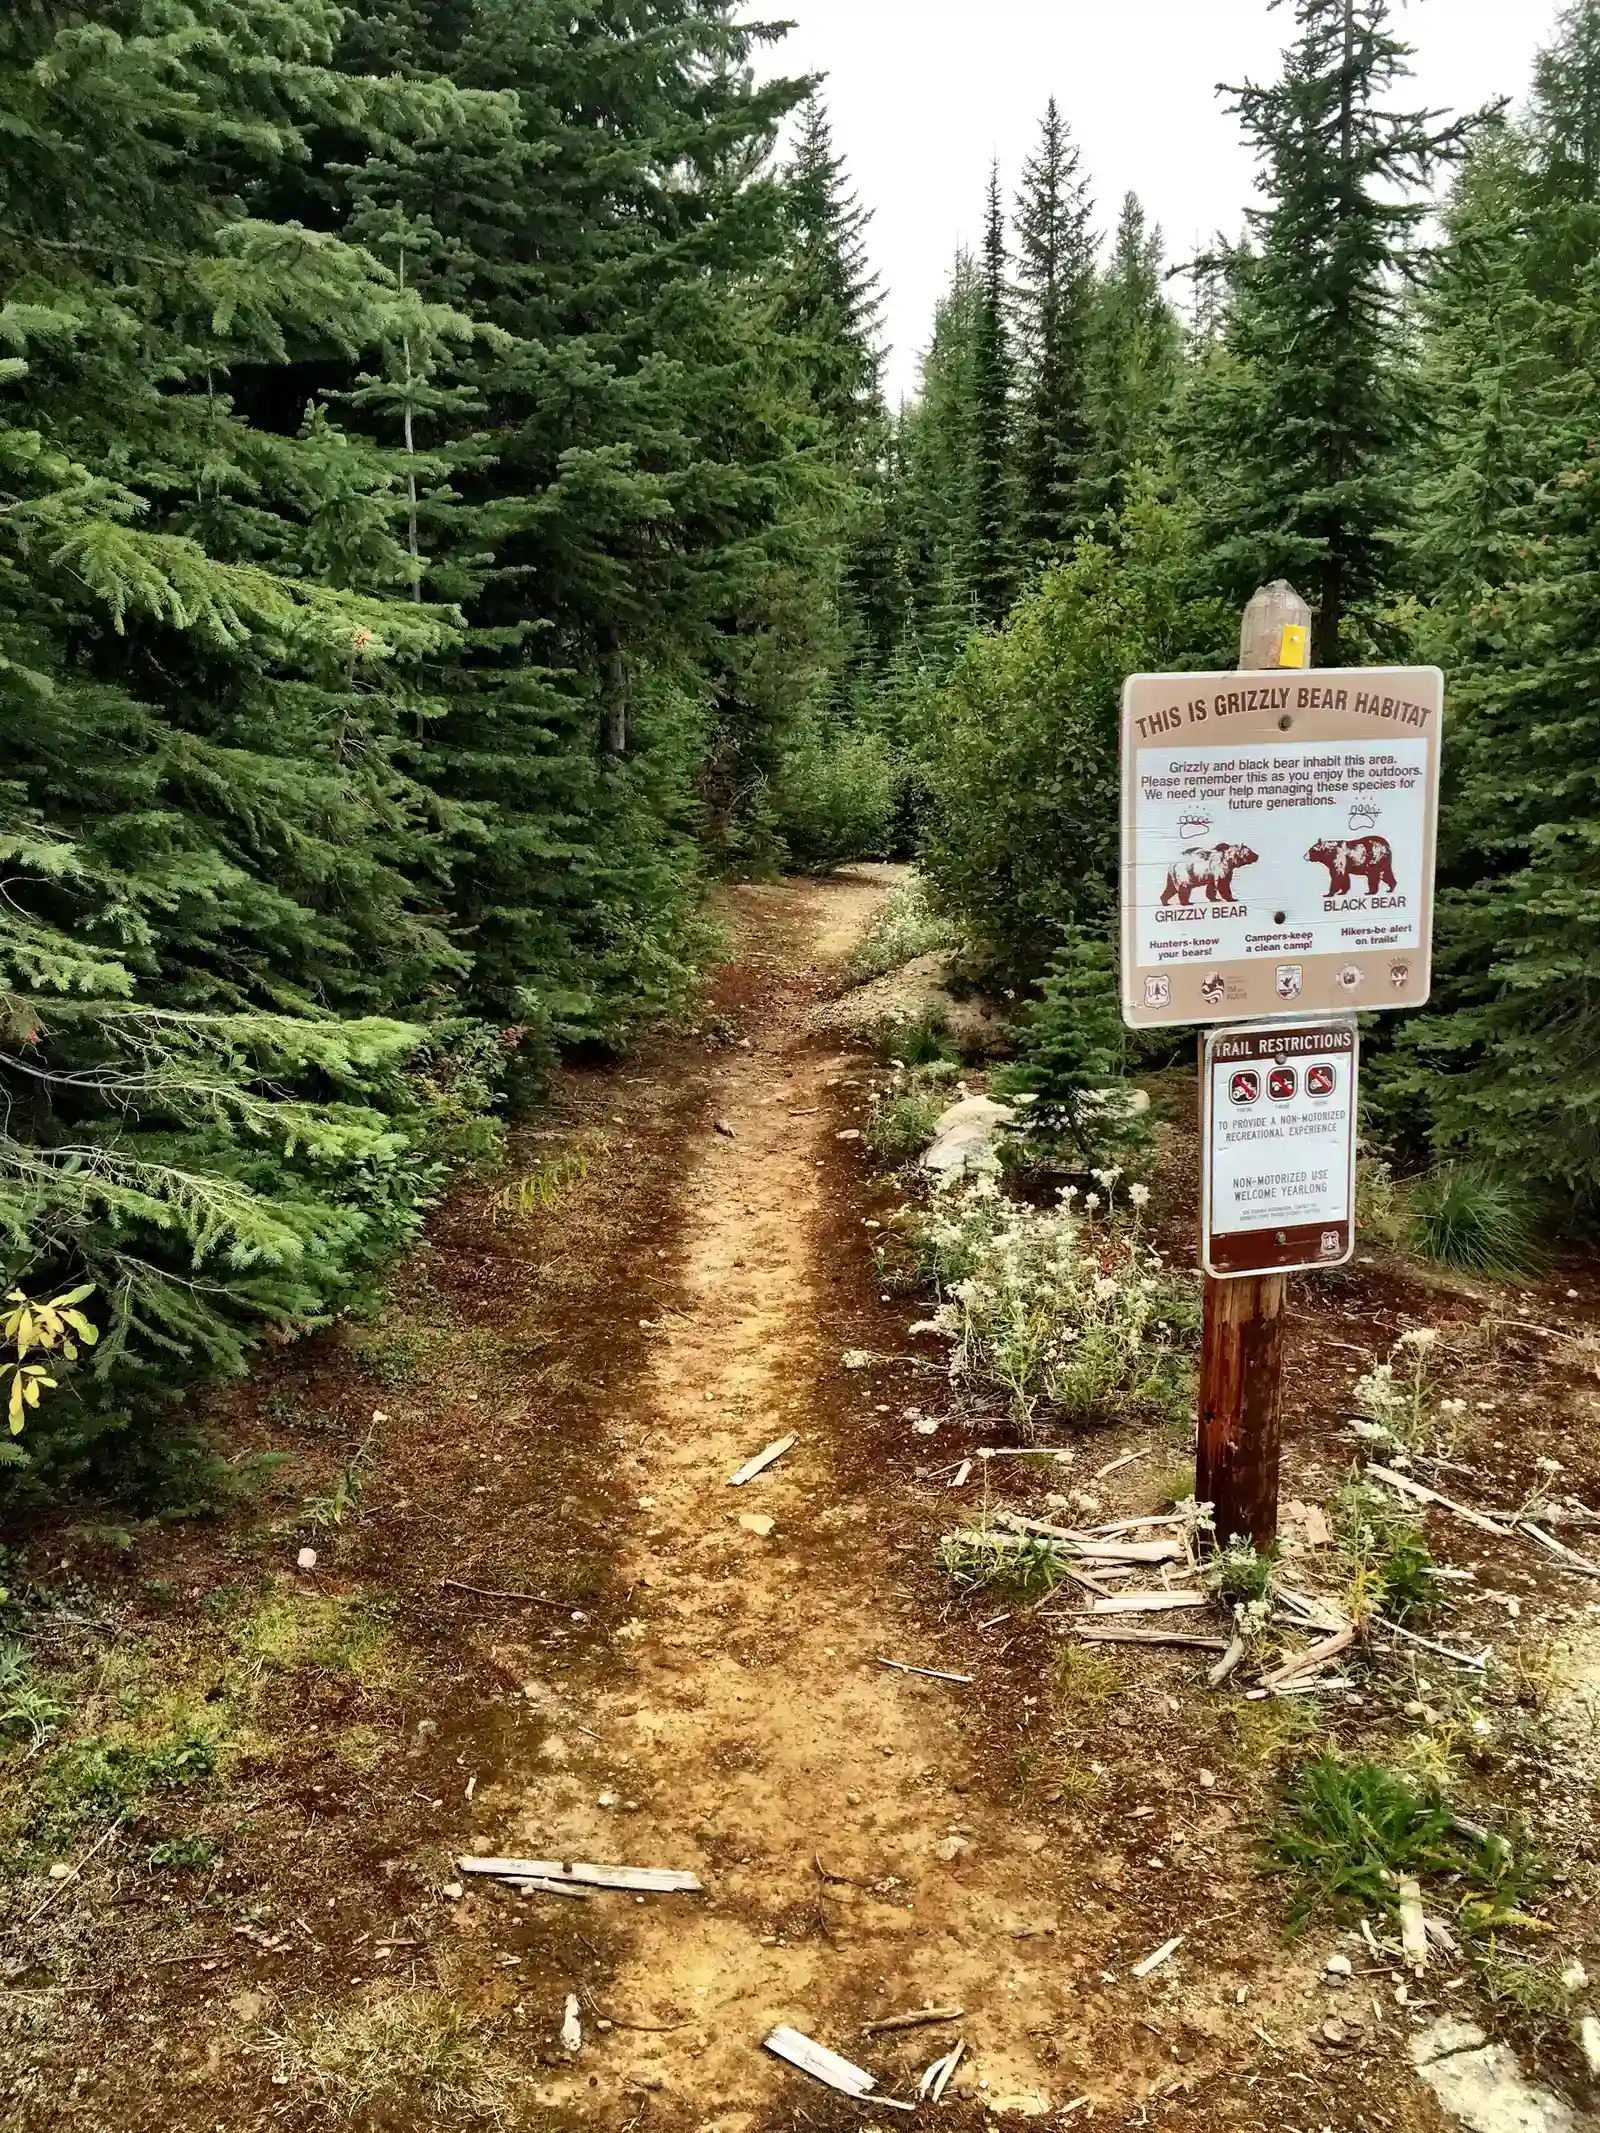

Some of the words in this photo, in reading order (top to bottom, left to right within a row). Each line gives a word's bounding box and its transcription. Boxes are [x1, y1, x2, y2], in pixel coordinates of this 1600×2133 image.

[1135, 706, 1182, 738] THIS
[1188, 699, 1207, 722] IS
[1215, 688, 1290, 716] GRIZZLY
[1297, 688, 1348, 710] BEAR
[1355, 692, 1431, 728] HABITAT
[1170, 761, 1209, 774] Grizzly
[1213, 760, 1234, 771] and
[1239, 758, 1269, 770] black
[1274, 758, 1299, 768] bear
[1304, 756, 1341, 767] inhabit
[1345, 755, 1365, 766] this
[1369, 755, 1397, 765] area.
[1141, 776, 1180, 787] Please
[1184, 773, 1243, 785] remember
[1247, 772, 1267, 782] this
[1272, 773, 1284, 781] as
[1289, 772, 1309, 783] you
[1313, 769, 1344, 782] enjoy
[1347, 768, 1364, 778] the
[1369, 766, 1422, 777] outdoors.
[1144, 789, 1162, 800] We
[1167, 787, 1196, 799] need
[1200, 788, 1225, 800] your
[1229, 785, 1253, 799] help
[1257, 782, 1313, 796] managing
[1317, 781, 1348, 792] these
[1352, 779, 1396, 792] species
[1399, 778, 1415, 789] for
[1228, 799, 1262, 810] future
[1267, 795, 1336, 810] generations.
[1324, 899, 1366, 912] BLACK
[1371, 896, 1406, 908] BEAR
[1155, 908, 1207, 922] GRIZZLY
[1212, 906, 1247, 919] BEAR
[1245, 931, 1313, 943] Campers-keep
[1341, 926, 1386, 936] Hikers-be
[1389, 924, 1412, 933] alert
[1150, 938, 1219, 949] Hunters-know
[1246, 945, 1251, 953] a
[1255, 941, 1280, 952] clean
[1283, 941, 1312, 951] camp!
[1355, 937, 1367, 945] on
[1371, 935, 1398, 944] trails!
[1158, 951, 1178, 961] your
[1182, 948, 1212, 957] bears!
[1215, 1041, 1253, 1057] TRAIL
[1259, 1032, 1351, 1053] RESTRICTIONS
[1218, 1120, 1228, 1131] TO
[1232, 1117, 1266, 1129] PROVIDE
[1271, 1117, 1276, 1125] A
[1280, 1110, 1346, 1124] NON-MOTORIZED
[1225, 1128, 1284, 1142] RECREATIONAL
[1289, 1123, 1337, 1136] EXPERIENCE
[1233, 1171, 1307, 1188] NON-MOTORIZED
[1311, 1169, 1328, 1180] USE
[1234, 1188, 1277, 1201] WELCOME
[1281, 1183, 1327, 1197] YEARLONG
